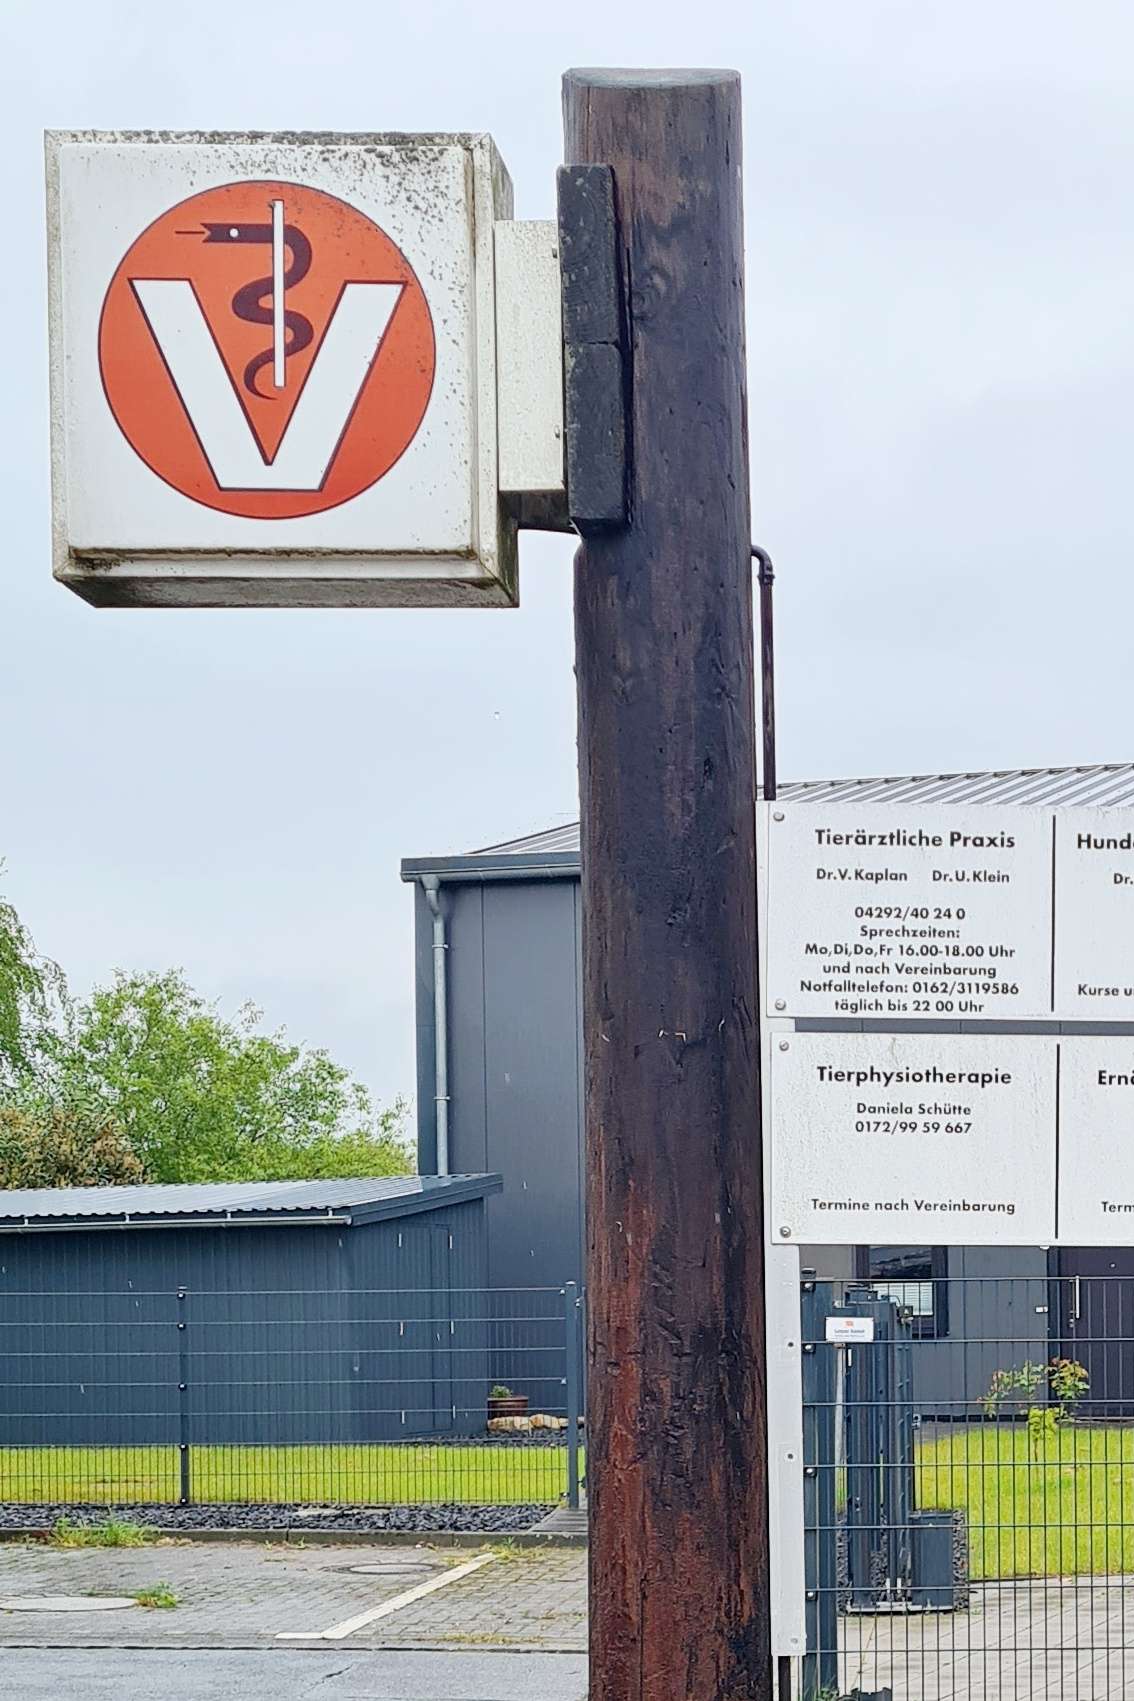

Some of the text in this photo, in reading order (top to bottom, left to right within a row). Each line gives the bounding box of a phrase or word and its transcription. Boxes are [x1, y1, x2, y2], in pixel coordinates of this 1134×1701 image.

[814, 828, 1016, 849] Tierärztliche Praxis
[854, 906, 966, 921] 04292/40 24 0
[860, 925, 960, 941] Sprechzeiten:
[899, 944, 985, 958] 16.00-18.00
[988, 944, 1016, 958] Uhr
[822, 962, 997, 979] und nach Vereinbarung
[800, 980, 1019, 996] Notfalltelefon: 0162/3119586
[1077, 984, 1120, 997] Kurse
[834, 998, 883, 1014] täglich
[887, 998, 908, 1012] bis
[958, 1000, 985, 1013] Uhr
[816, 1065, 1012, 1088] Tierphysiotherapie
[856, 1102, 971, 1116] Daniela Schütte
[855, 1120, 972, 1135] 0172/99 59 667
[811, 1198, 1015, 1215] Termine nach Vereinbarung
